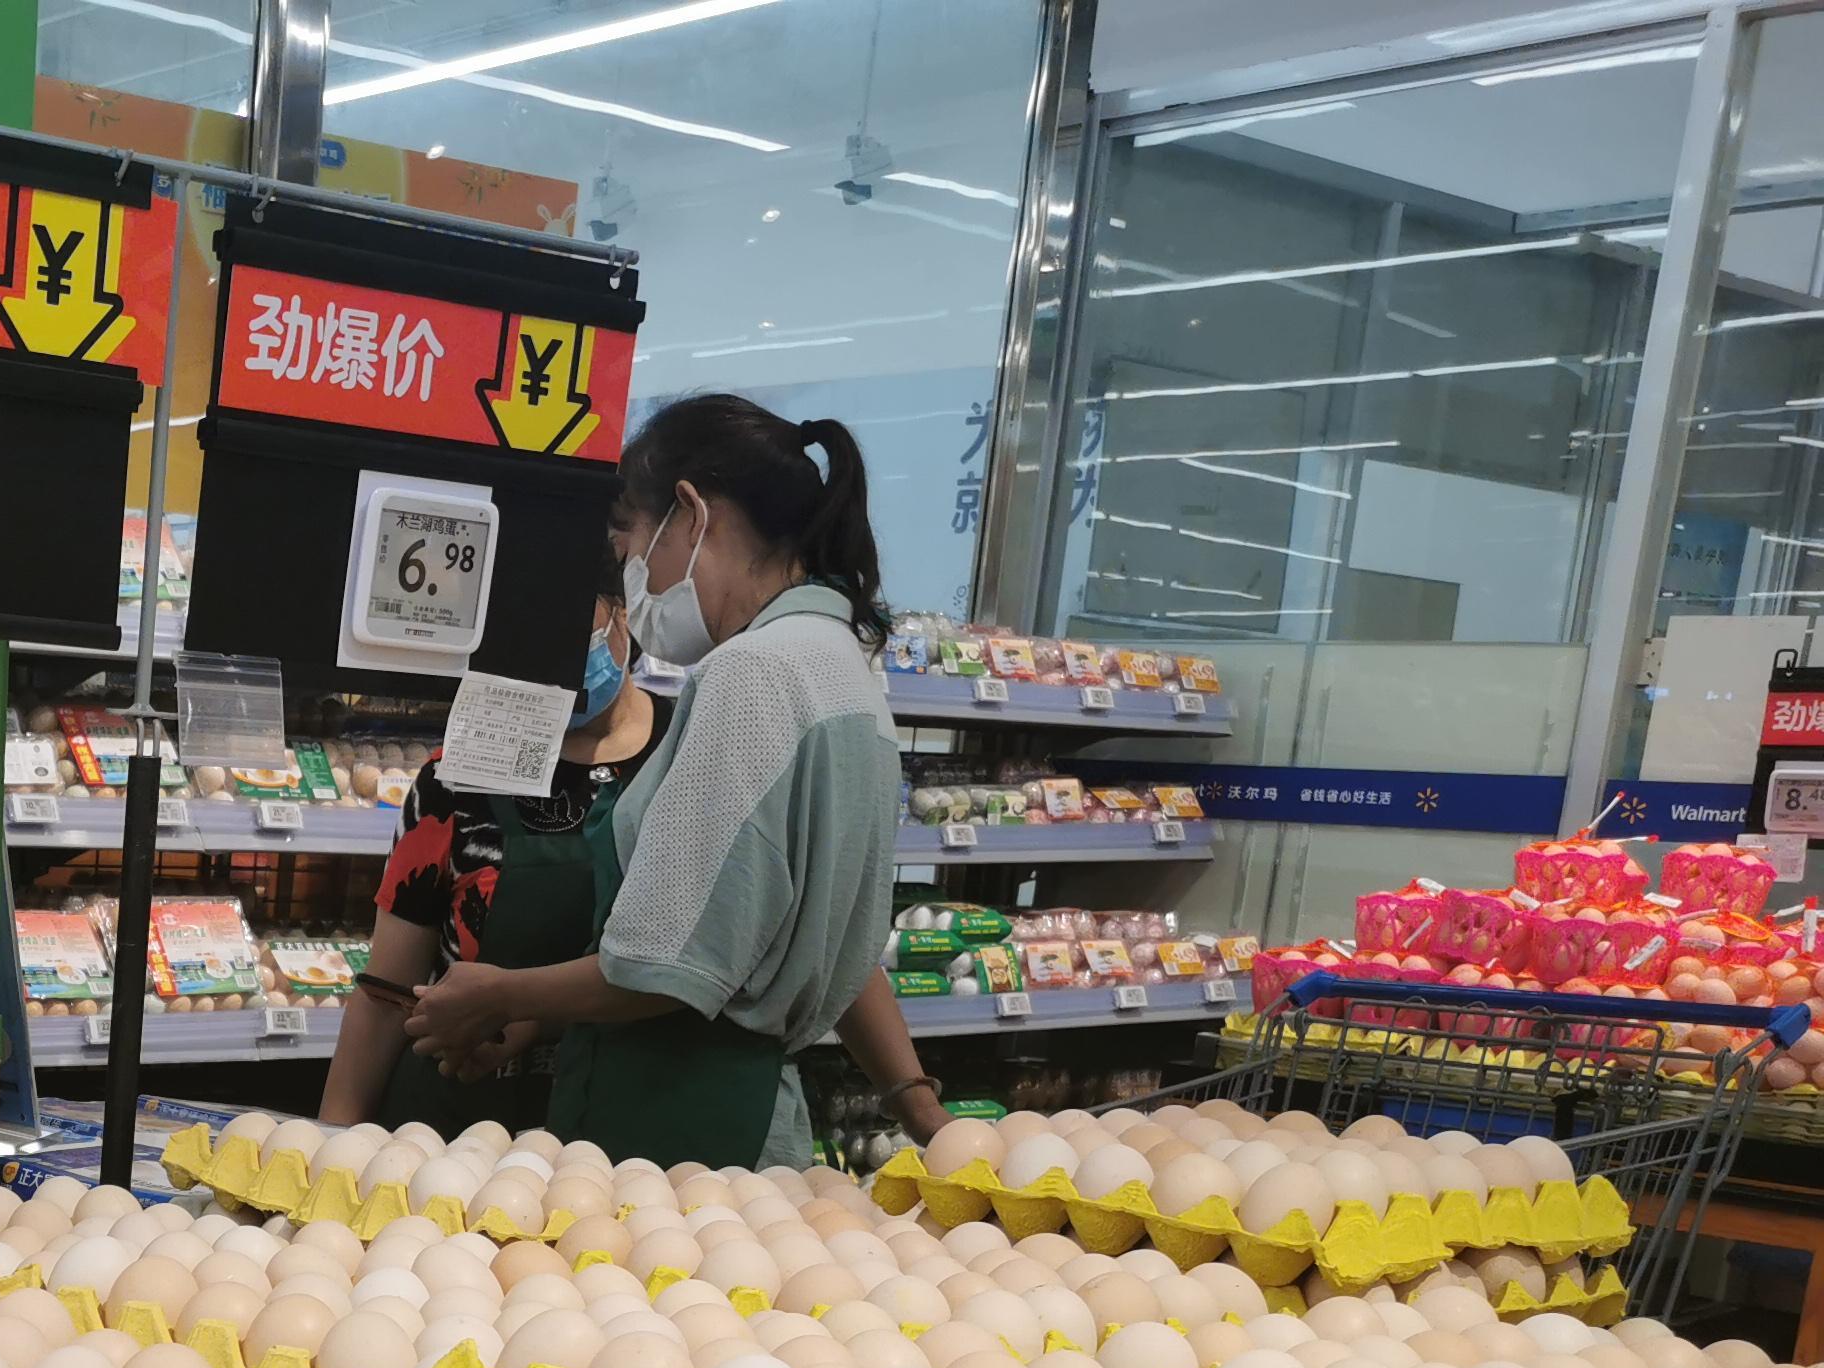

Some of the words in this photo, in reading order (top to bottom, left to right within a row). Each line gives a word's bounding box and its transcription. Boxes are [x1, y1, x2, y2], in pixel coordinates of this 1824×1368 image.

[244, 294, 445, 402] 劲爆价
[1228, 786, 1279, 802] 沃尔玛
[1300, 788, 1393, 806] 省钱省心好生活
[1671, 804, 1747, 823] Walmart
